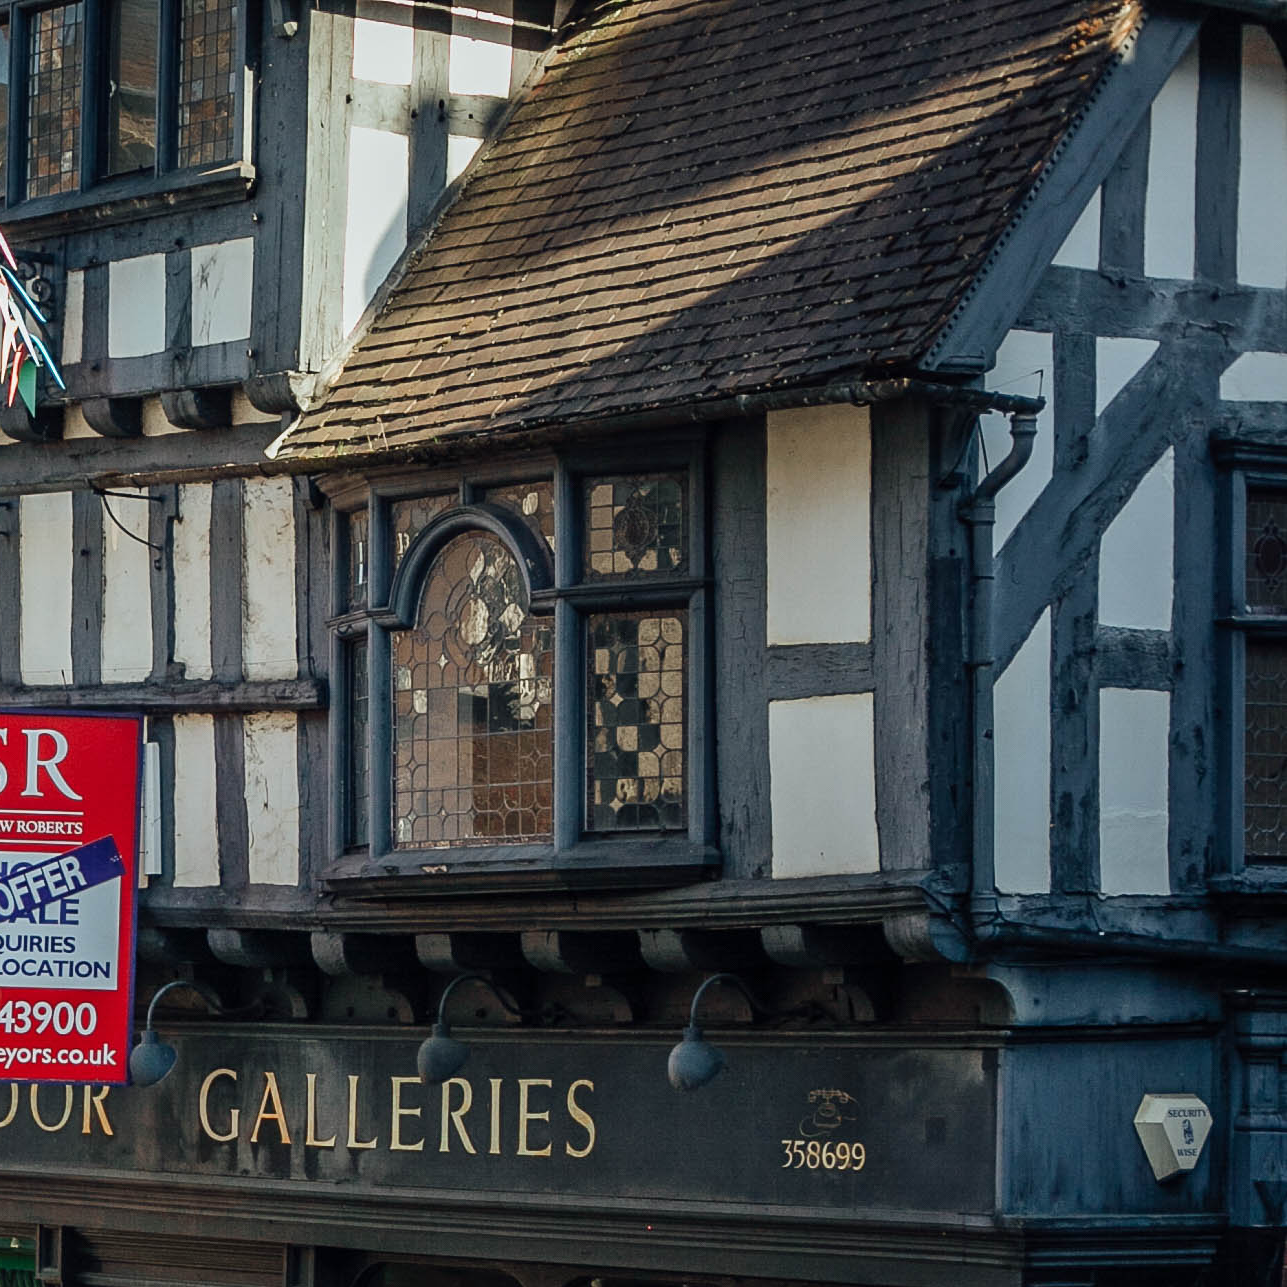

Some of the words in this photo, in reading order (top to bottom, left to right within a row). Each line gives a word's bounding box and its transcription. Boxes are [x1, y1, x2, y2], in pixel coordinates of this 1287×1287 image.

[16, 820, 83, 835] ROBERTS
[9, 898, 80, 925] ALE
[199, 1068, 597, 1158] GALLERIES
[1167, 1108, 1207, 1118] SECURITY
[780, 1139, 866, 1172] 358699
[1177, 1148, 1199, 1157] WISE
